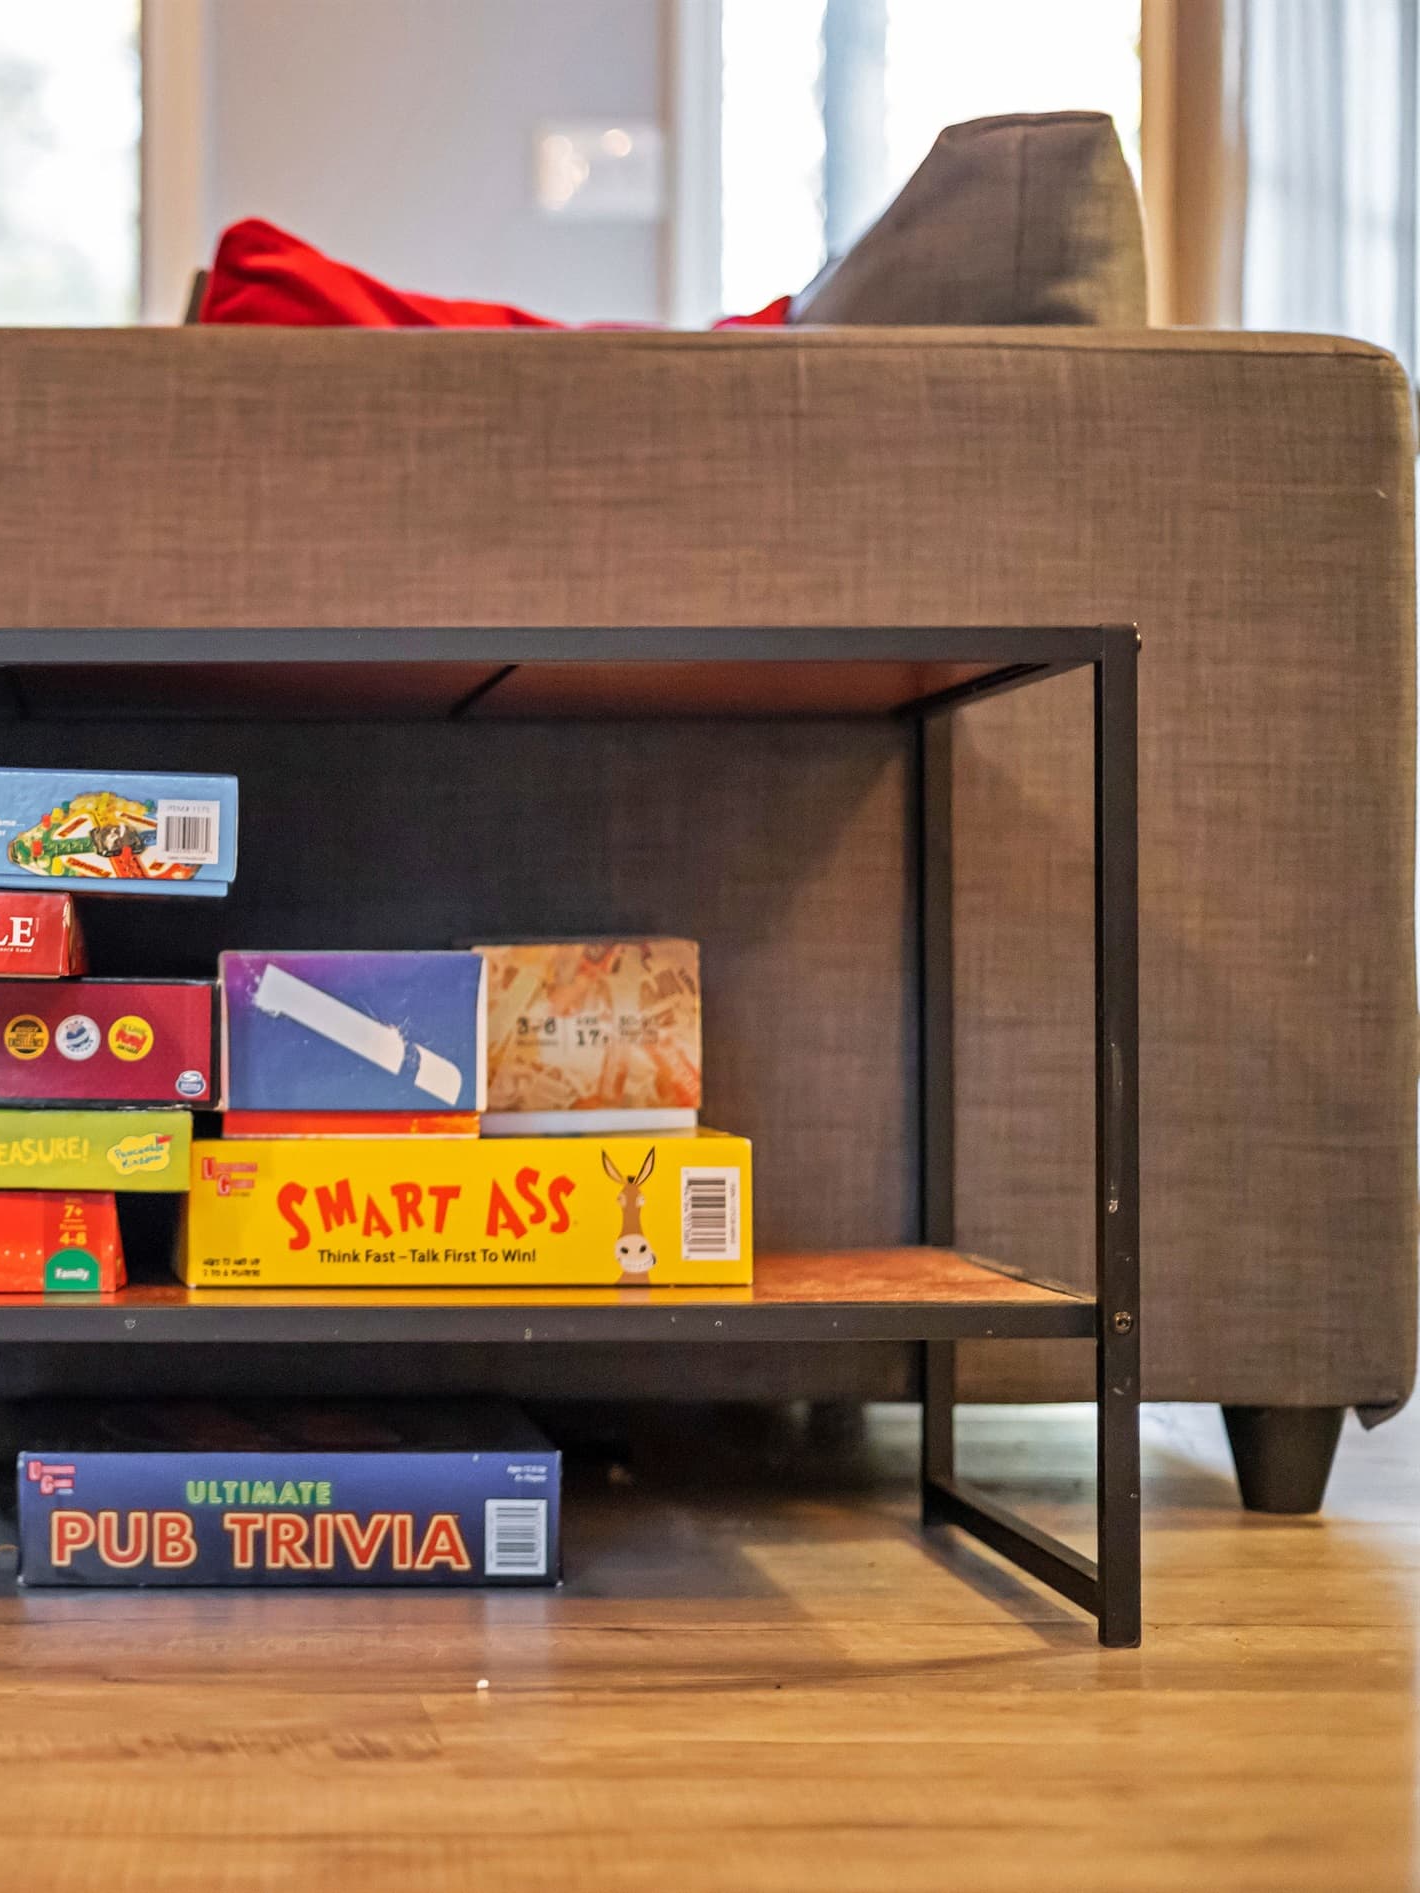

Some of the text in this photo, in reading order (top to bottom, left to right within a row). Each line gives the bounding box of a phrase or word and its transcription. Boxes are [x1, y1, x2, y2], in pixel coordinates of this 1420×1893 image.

[516, 1016, 557, 1035] 3-6
[64, 1204, 84, 1219] 7+
[276, 1166, 577, 1251] SMART ASS
[318, 1249, 361, 1263] Think
[364, 1249, 396, 1263] Fast
[409, 1249, 439, 1263] Talk
[444, 1249, 477, 1263] First
[481, 1249, 499, 1263] To
[501, 1248, 537, 1263] Win!
[54, 1267, 91, 1281] Family
[186, 1481, 332, 1505] ULTIMATE
[50, 1511, 473, 1570] PUB TRIVIA
